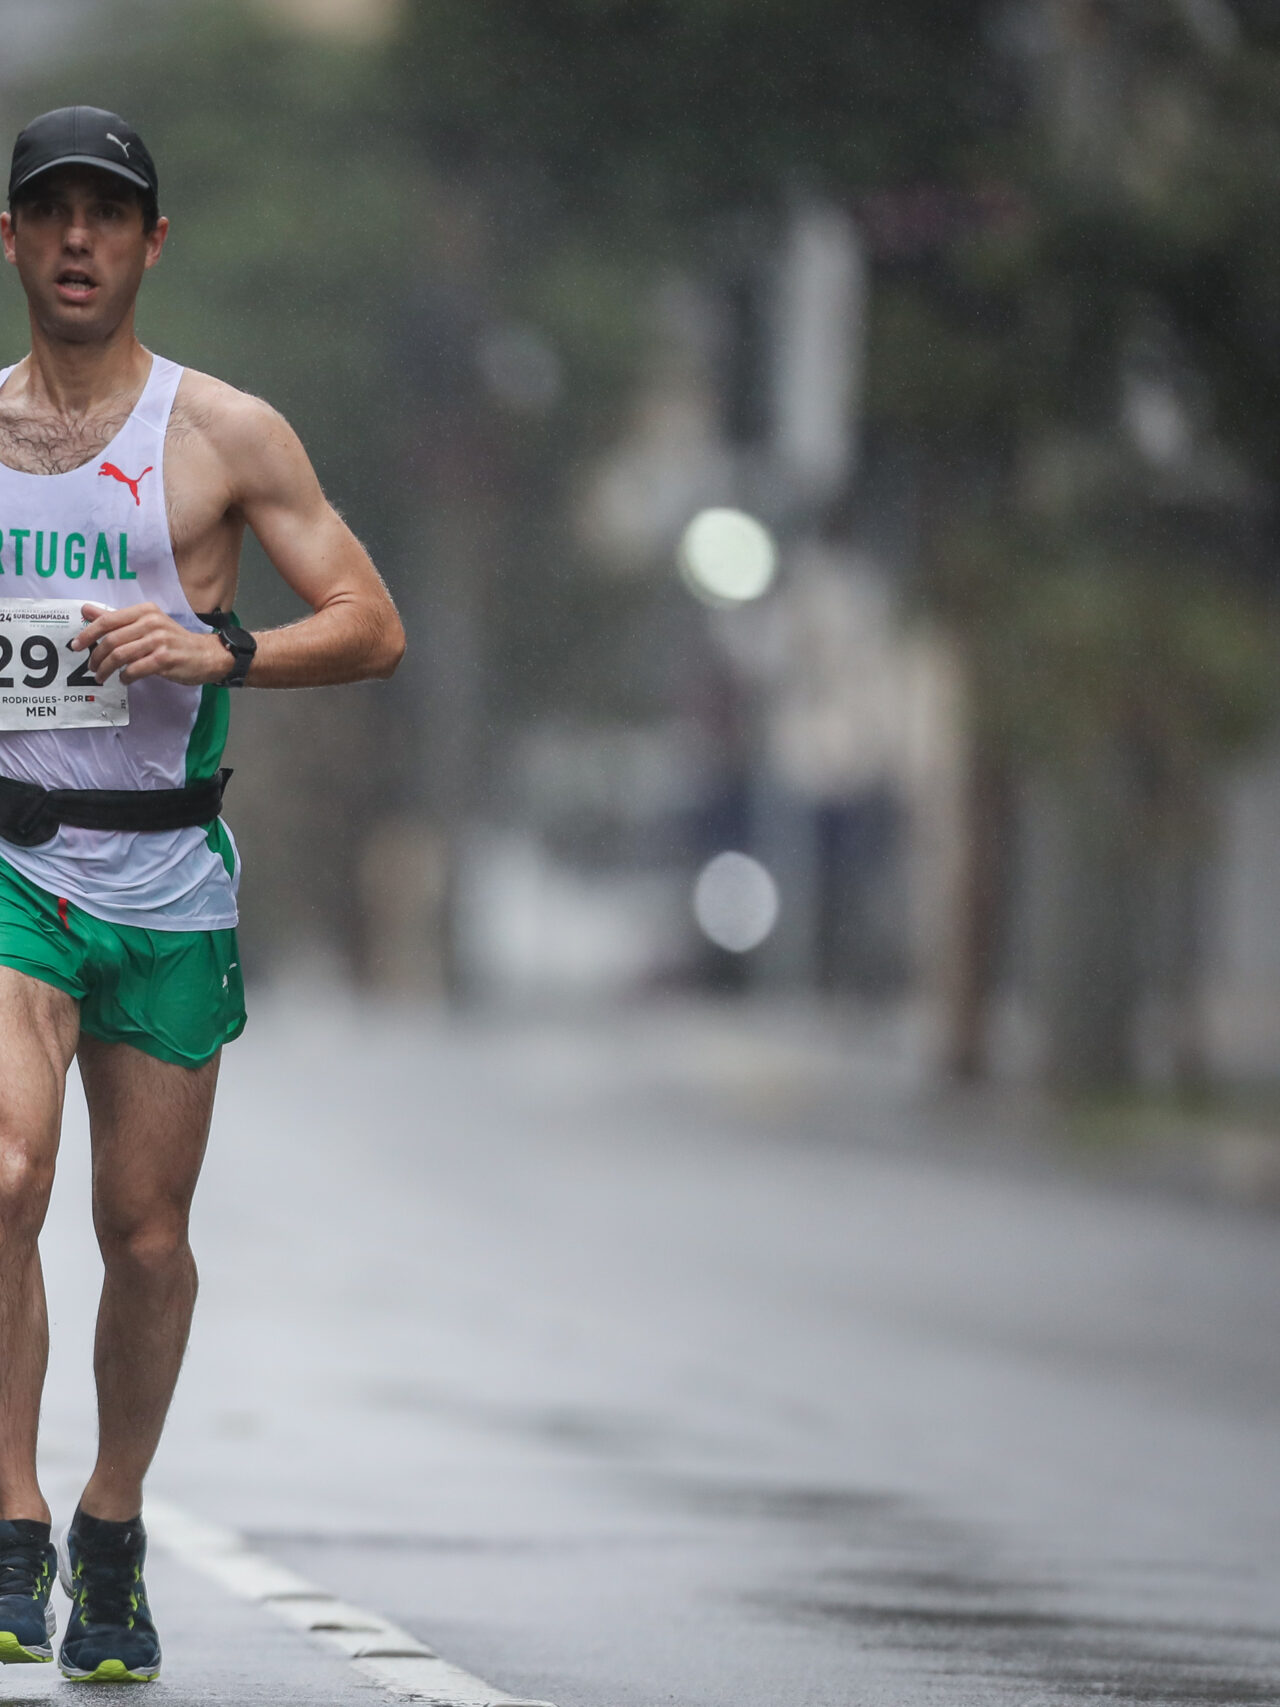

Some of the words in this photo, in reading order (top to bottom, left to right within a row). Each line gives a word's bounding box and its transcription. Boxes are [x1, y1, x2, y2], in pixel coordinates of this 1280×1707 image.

[0, 613, 12, 622] 24
[64, 695, 84, 703] POR
[26, 706, 57, 717] MEN
